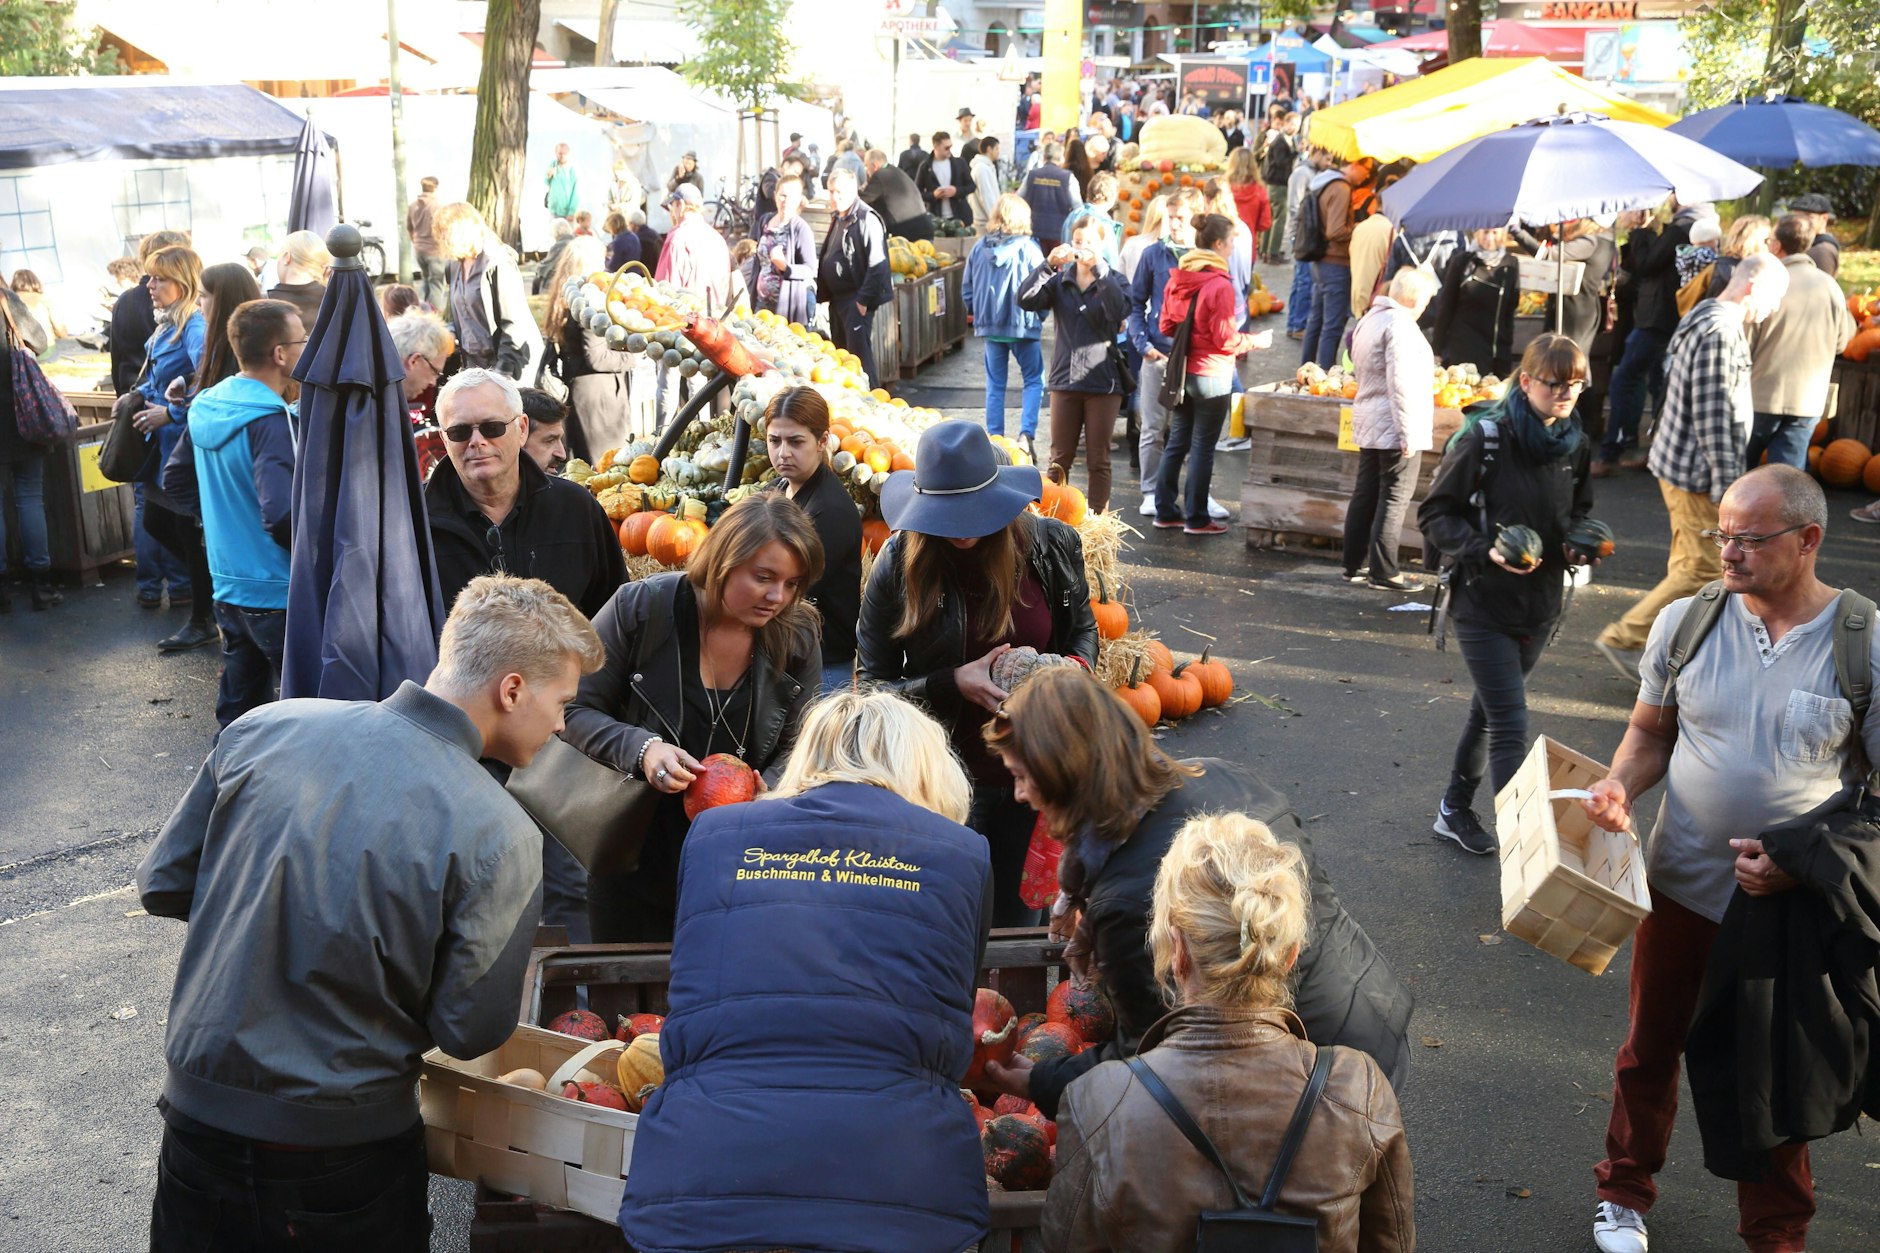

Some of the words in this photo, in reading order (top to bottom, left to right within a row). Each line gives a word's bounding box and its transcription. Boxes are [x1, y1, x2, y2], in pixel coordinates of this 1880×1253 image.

[880, 20, 938, 31] APOTHEKE
[744, 848, 840, 869] Spargelhof
[845, 850, 921, 872] Klaistow
[736, 869, 816, 881] Buschmann
[821, 870, 832, 882] &
[836, 870, 921, 892] Winkelmann
